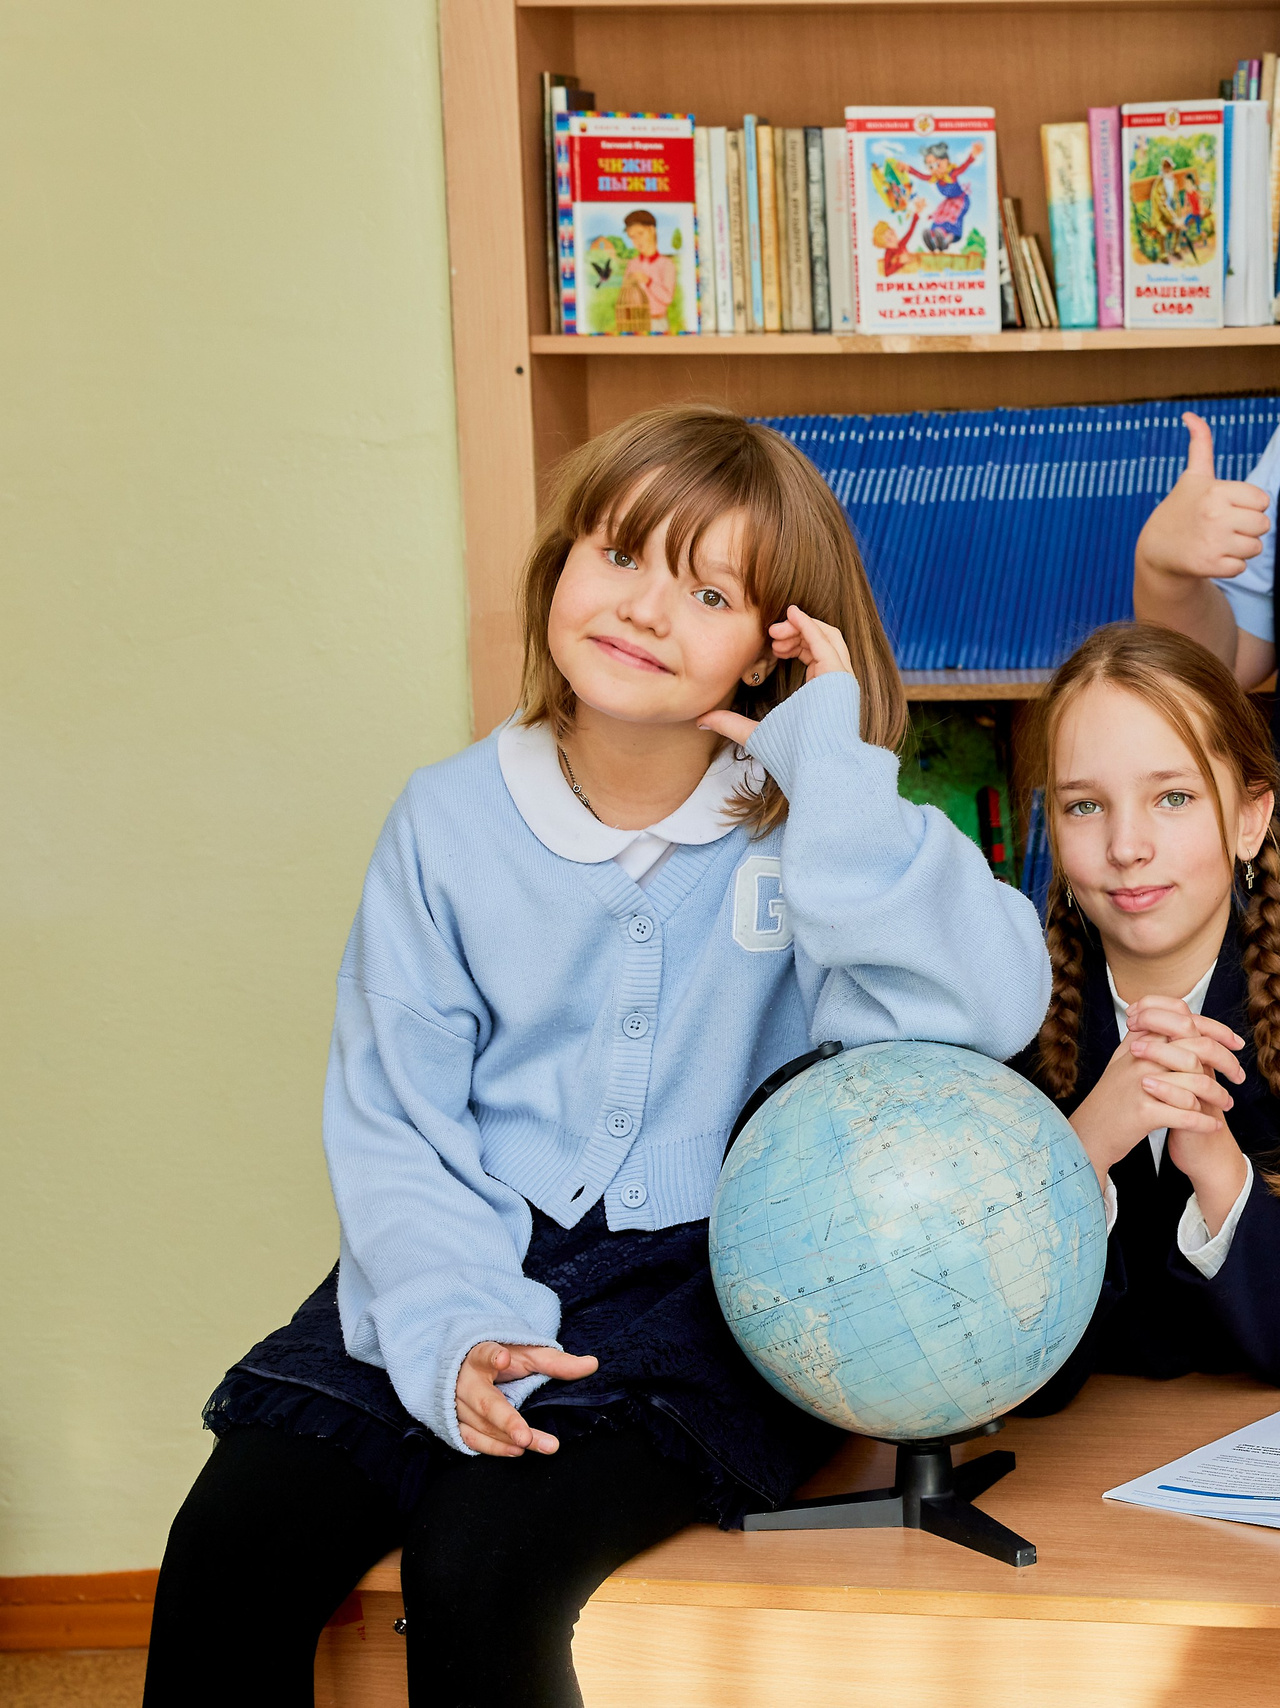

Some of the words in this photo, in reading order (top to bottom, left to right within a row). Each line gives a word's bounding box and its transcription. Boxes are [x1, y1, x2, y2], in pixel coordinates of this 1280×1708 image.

[598, 176, 671, 192] ПЫЖИК
[876, 281, 985, 292] ПРИКЛЮЧЕНИЯ
[1135, 286, 1210, 298] ВОЛШЕБНОЕ
[878, 307, 986, 319] ЧЕМОДАНЧИКА
[1153, 303, 1193, 315] СЛОВО
[733, 855, 795, 953] G
